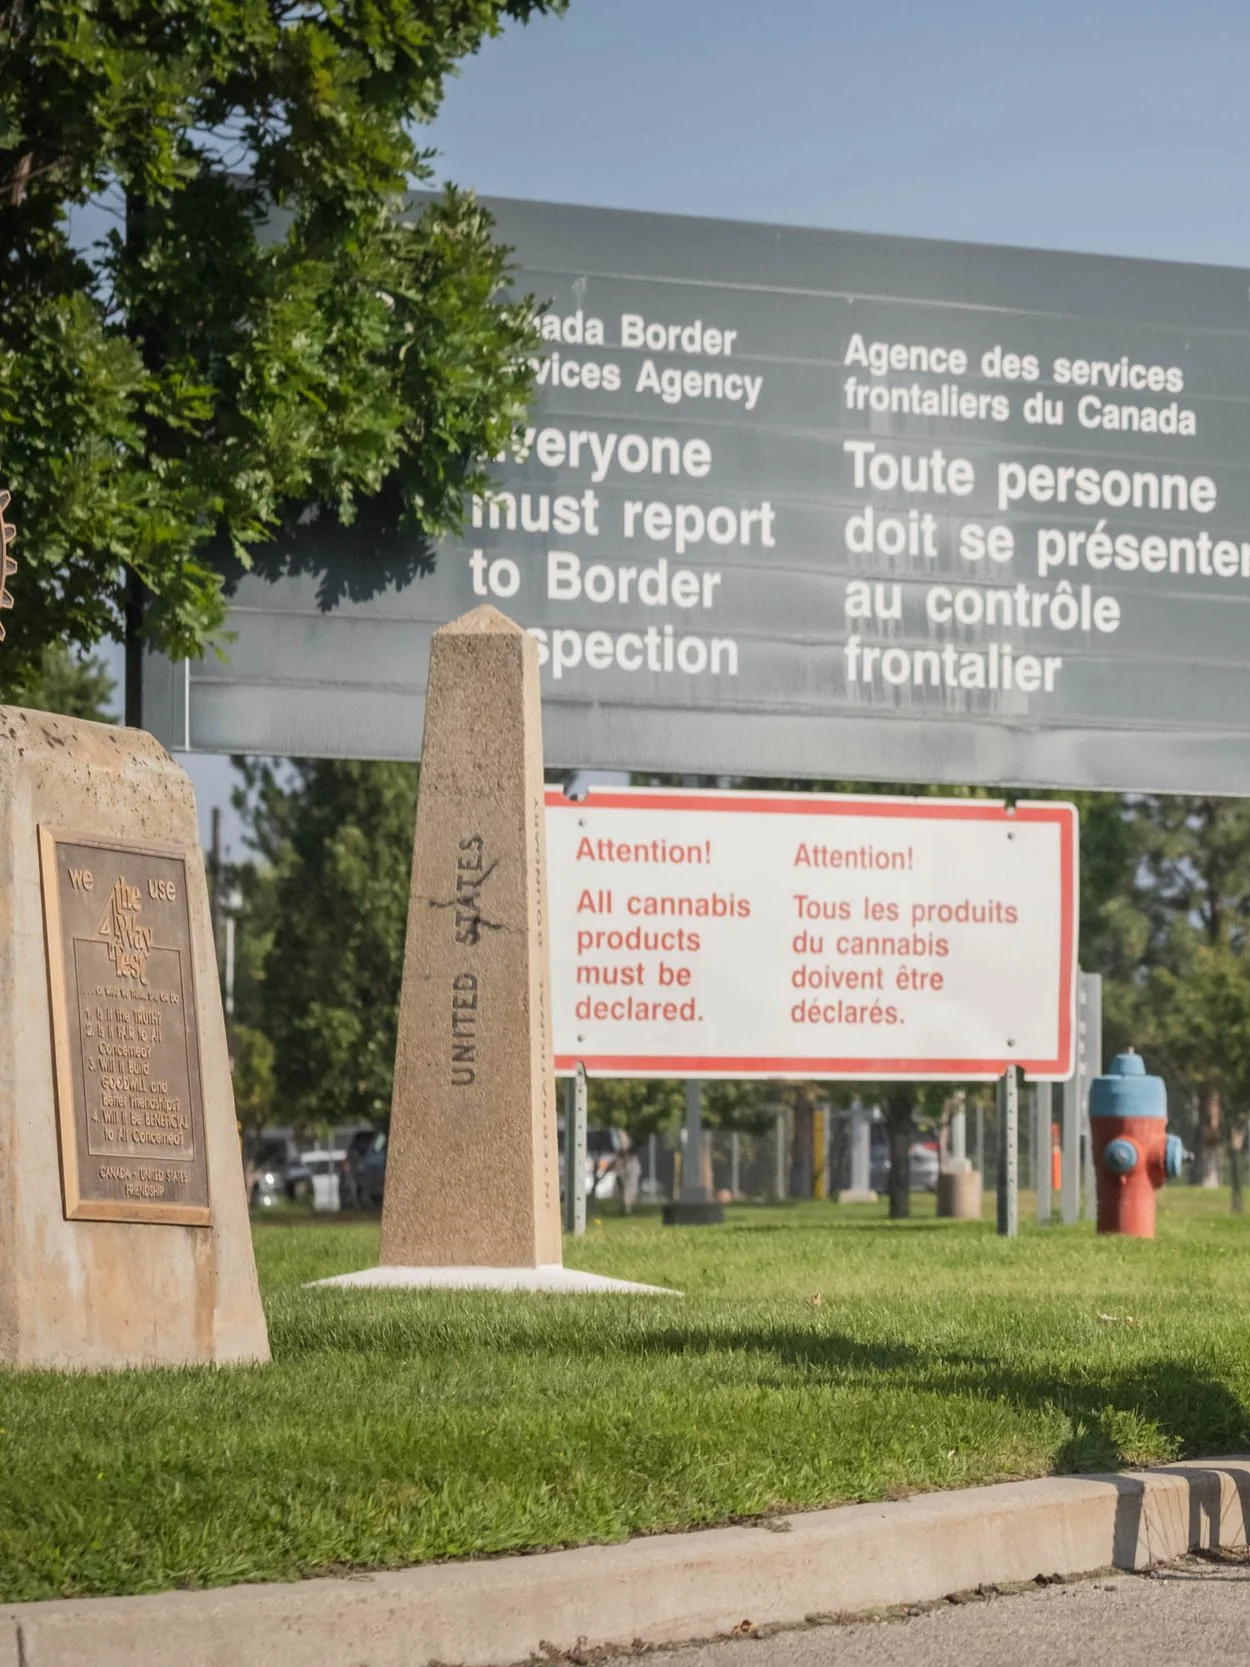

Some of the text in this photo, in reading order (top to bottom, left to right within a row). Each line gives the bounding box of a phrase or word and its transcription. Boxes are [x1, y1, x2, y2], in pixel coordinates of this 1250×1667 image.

[533, 310, 739, 356] ada Border
[843, 333, 1184, 393] Agence des services
[636, 359, 764, 410] Agency
[843, 377, 1196, 436] frontaliers du Canada
[843, 440, 1217, 513] Toute personne
[471, 488, 775, 553] must report
[844, 505, 938, 558] doit
[959, 523, 1015, 562] se
[468, 549, 722, 609] to Border
[844, 579, 1121, 633] au contrôle
[526, 624, 739, 679] spection
[843, 636, 1062, 692] frontalier
[575, 836, 712, 865] Attention!
[793, 843, 914, 871] Attention!
[68, 867, 176, 902] we use
[114, 876, 141, 915] the
[577, 889, 751, 919] All cannabis
[793, 894, 1018, 927] Tous les produits
[116, 914, 153, 960] Way
[577, 927, 700, 956] products
[792, 929, 949, 957] du cannabis
[113, 944, 147, 986] Test
[451, 834, 484, 1086] UNITED STATES
[576, 961, 691, 986] must be
[791, 963, 944, 991] doivent être
[575, 996, 704, 1023] declared.
[791, 996, 905, 1025] déclarés.
[101, 1075, 147, 1092] GOODWILL
